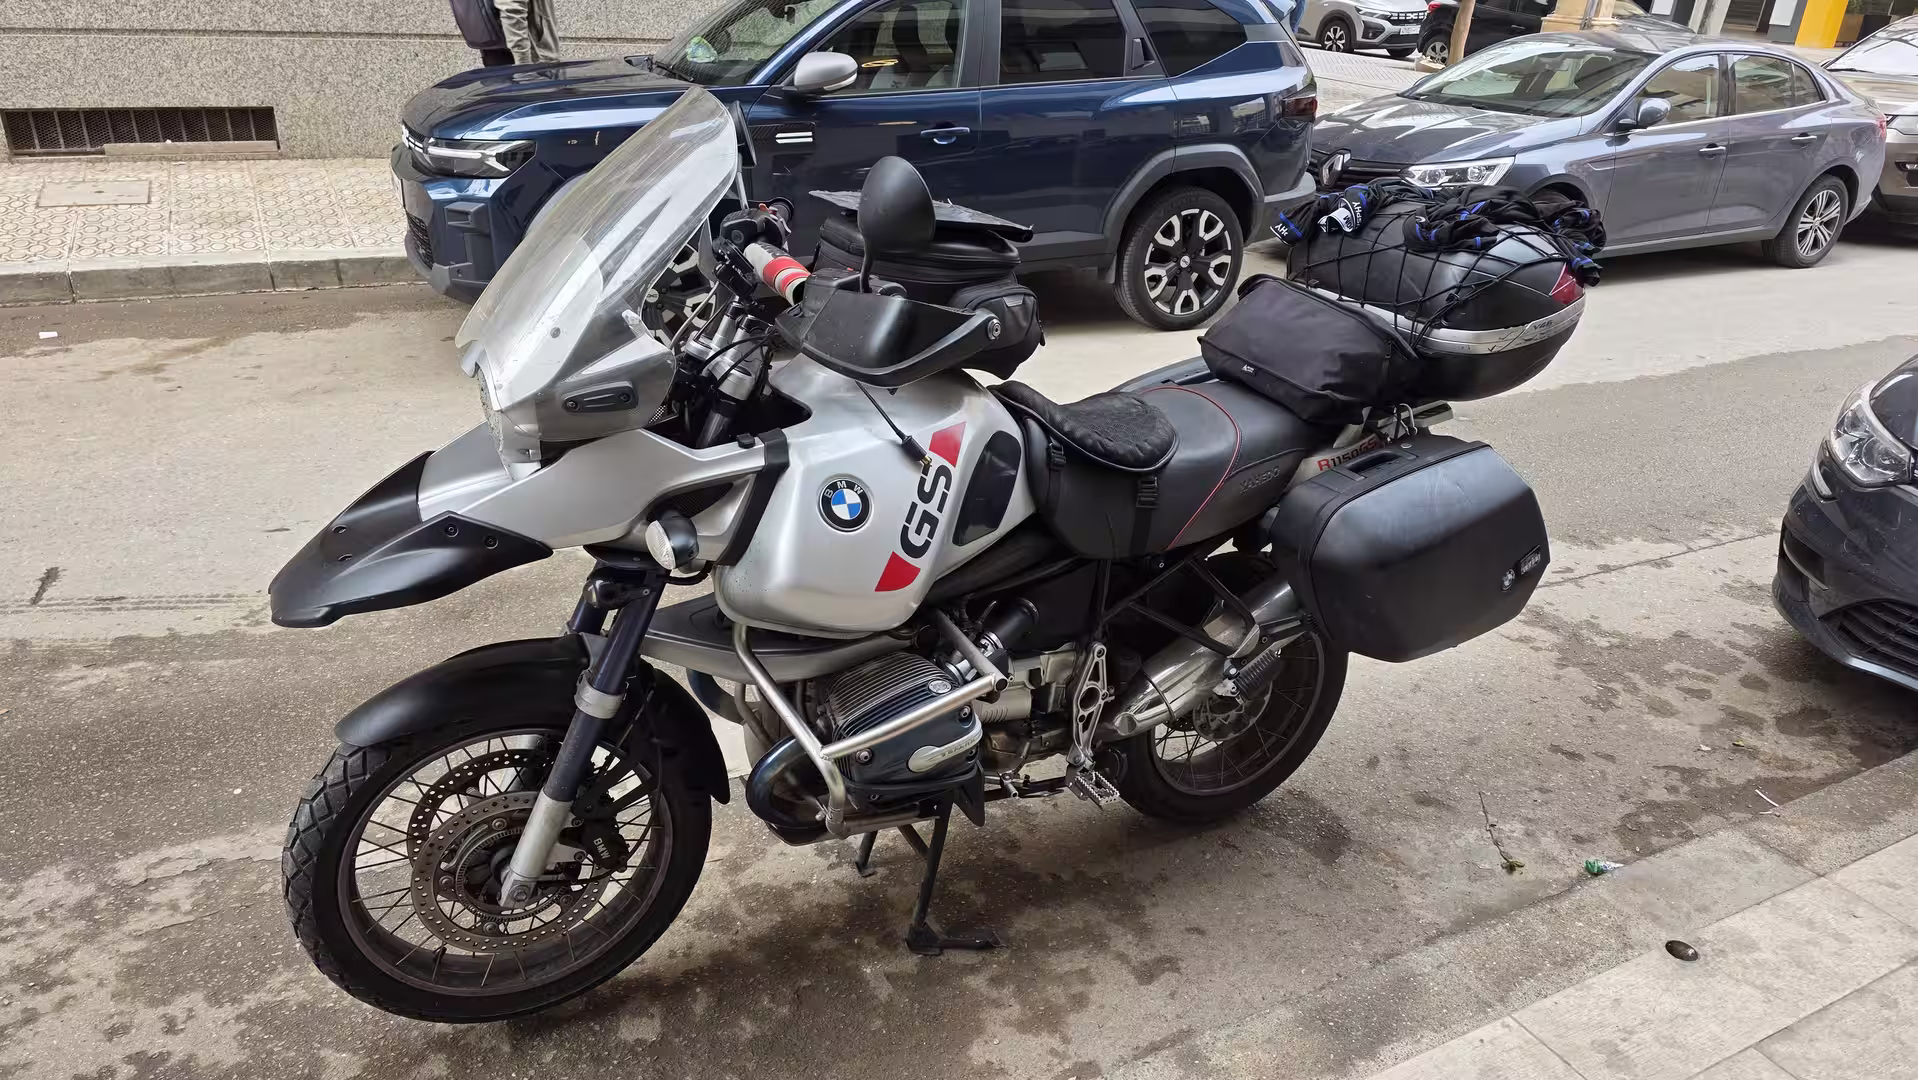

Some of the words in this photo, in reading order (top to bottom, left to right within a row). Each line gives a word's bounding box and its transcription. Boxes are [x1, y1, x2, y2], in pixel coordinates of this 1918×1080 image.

[1317, 437, 1377, 471] R1150GS
[823, 480, 864, 499] BMW
[900, 464, 953, 559] GS
[593, 837, 611, 859] BMW
